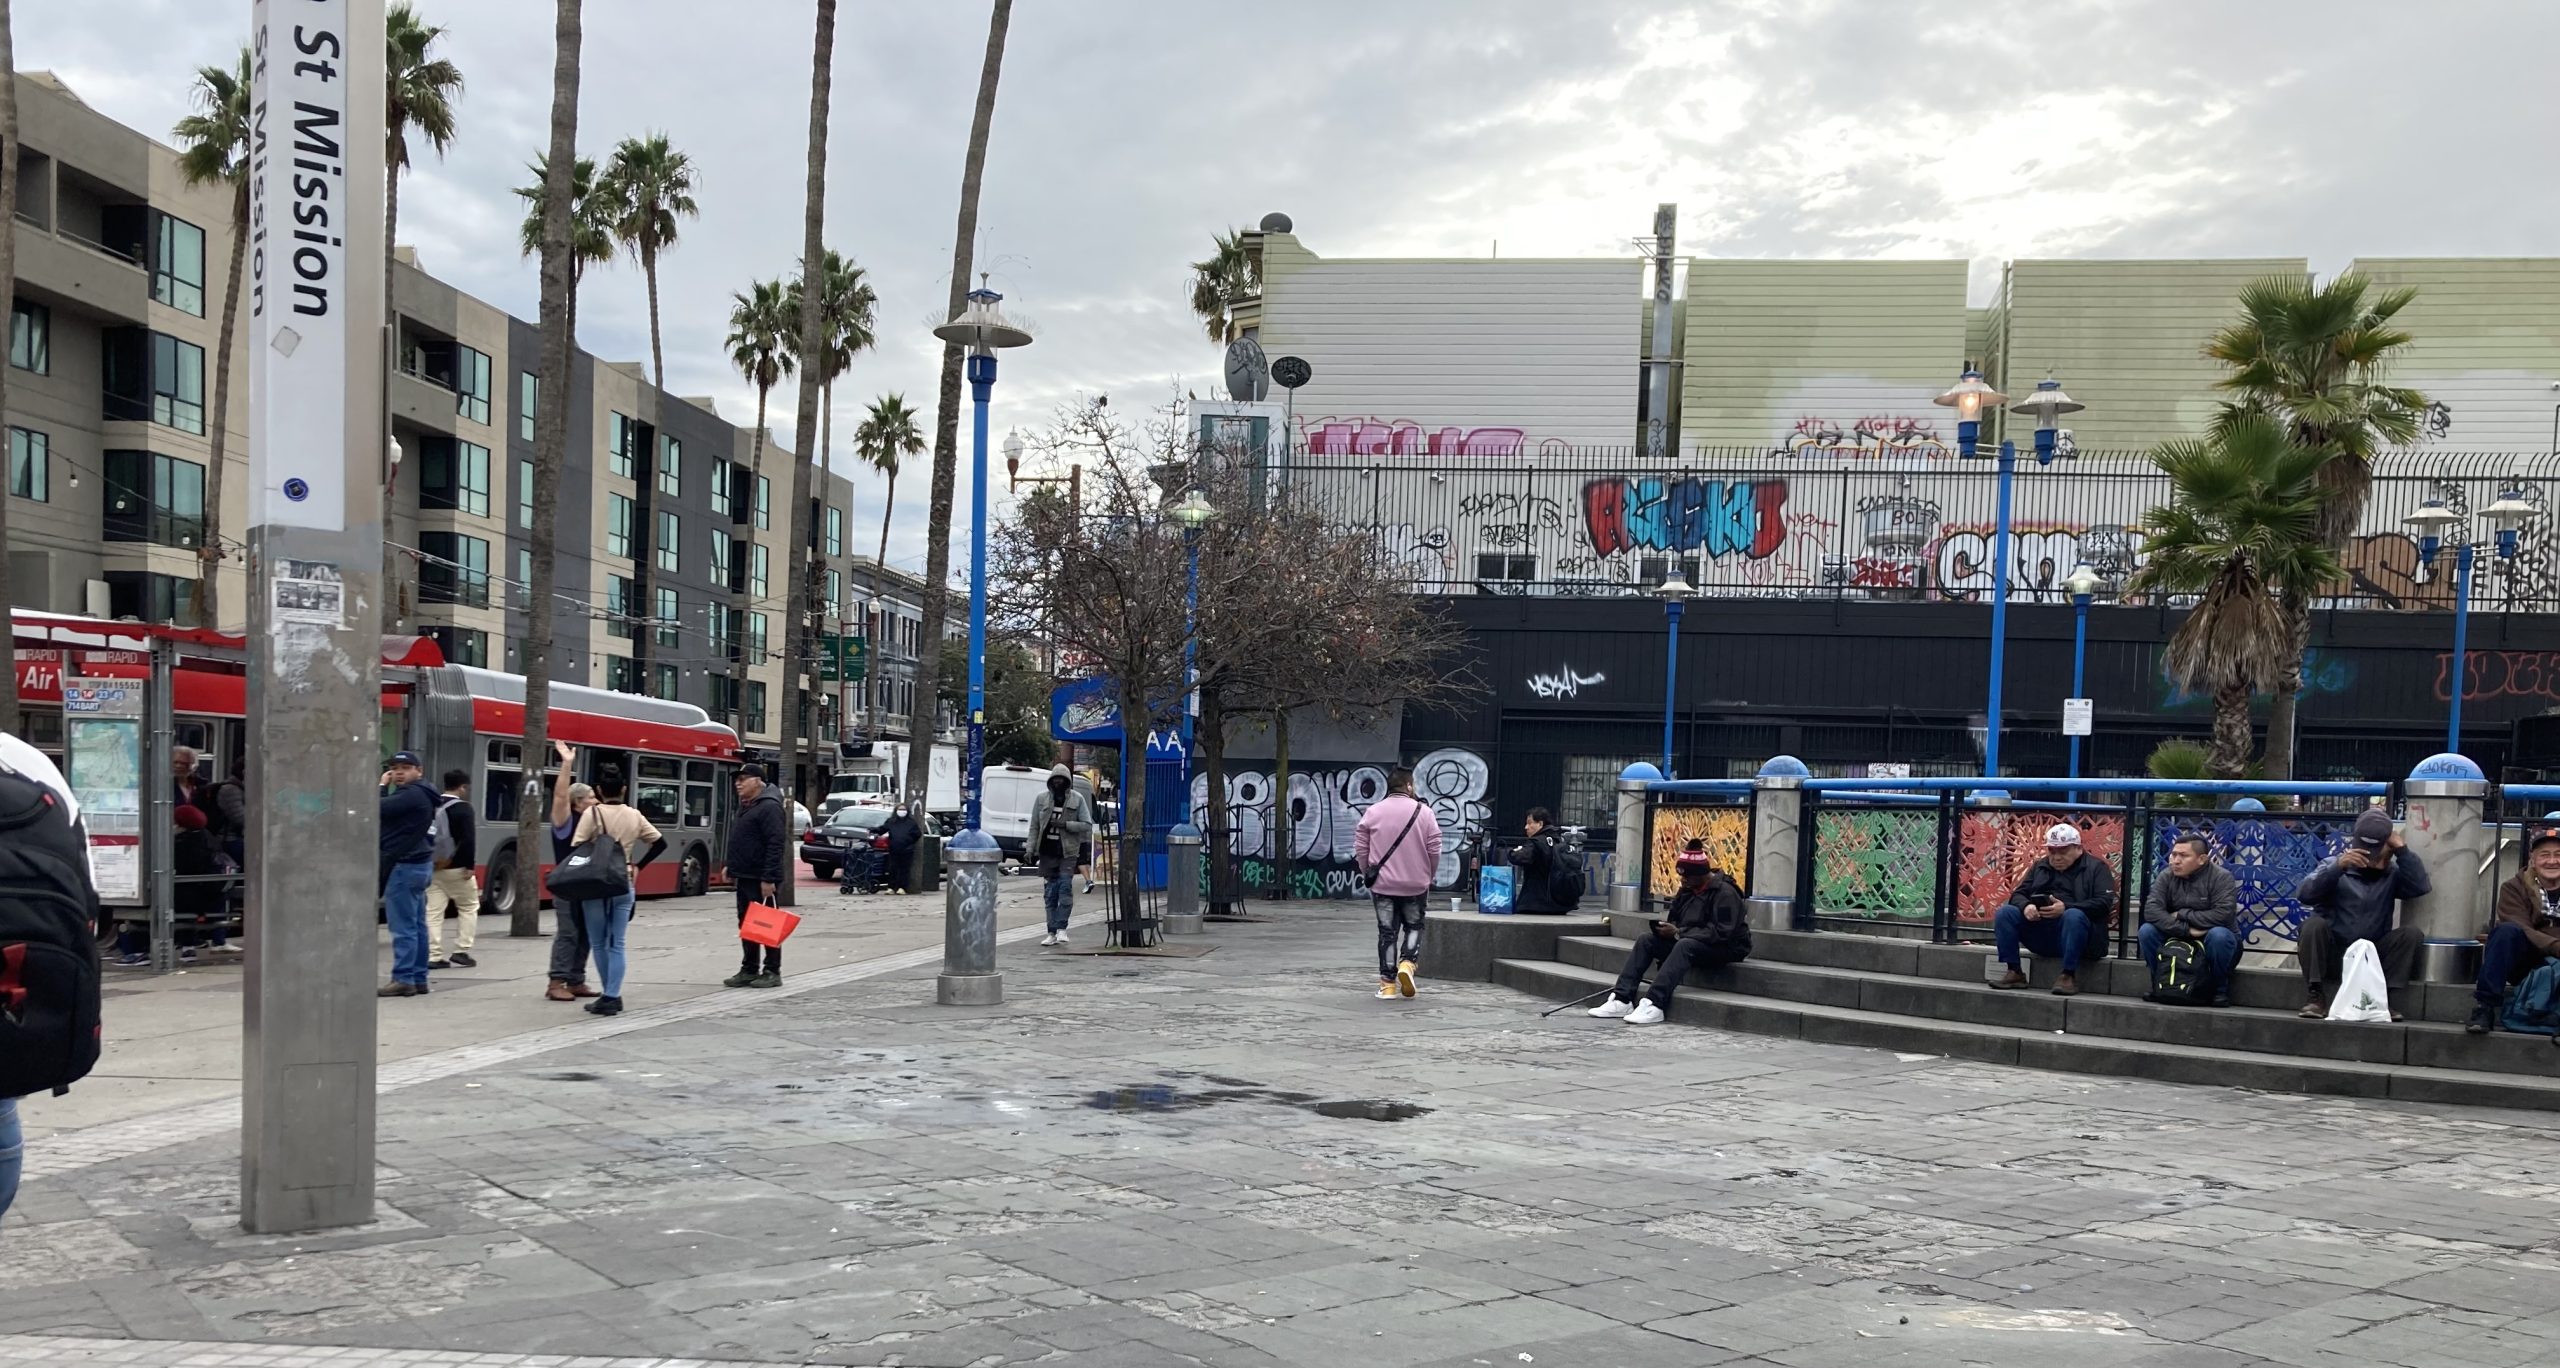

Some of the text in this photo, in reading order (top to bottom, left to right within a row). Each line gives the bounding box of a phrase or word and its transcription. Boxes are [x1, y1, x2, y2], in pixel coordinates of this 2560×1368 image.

[254, 24, 267, 318] St Mission
[293, 24, 342, 317] St Mission
[26, 650, 57, 661] RAPID
[107, 652, 138, 663] RAPID
[22, 666, 54, 690] Air
[81, 702, 99, 710] BART
